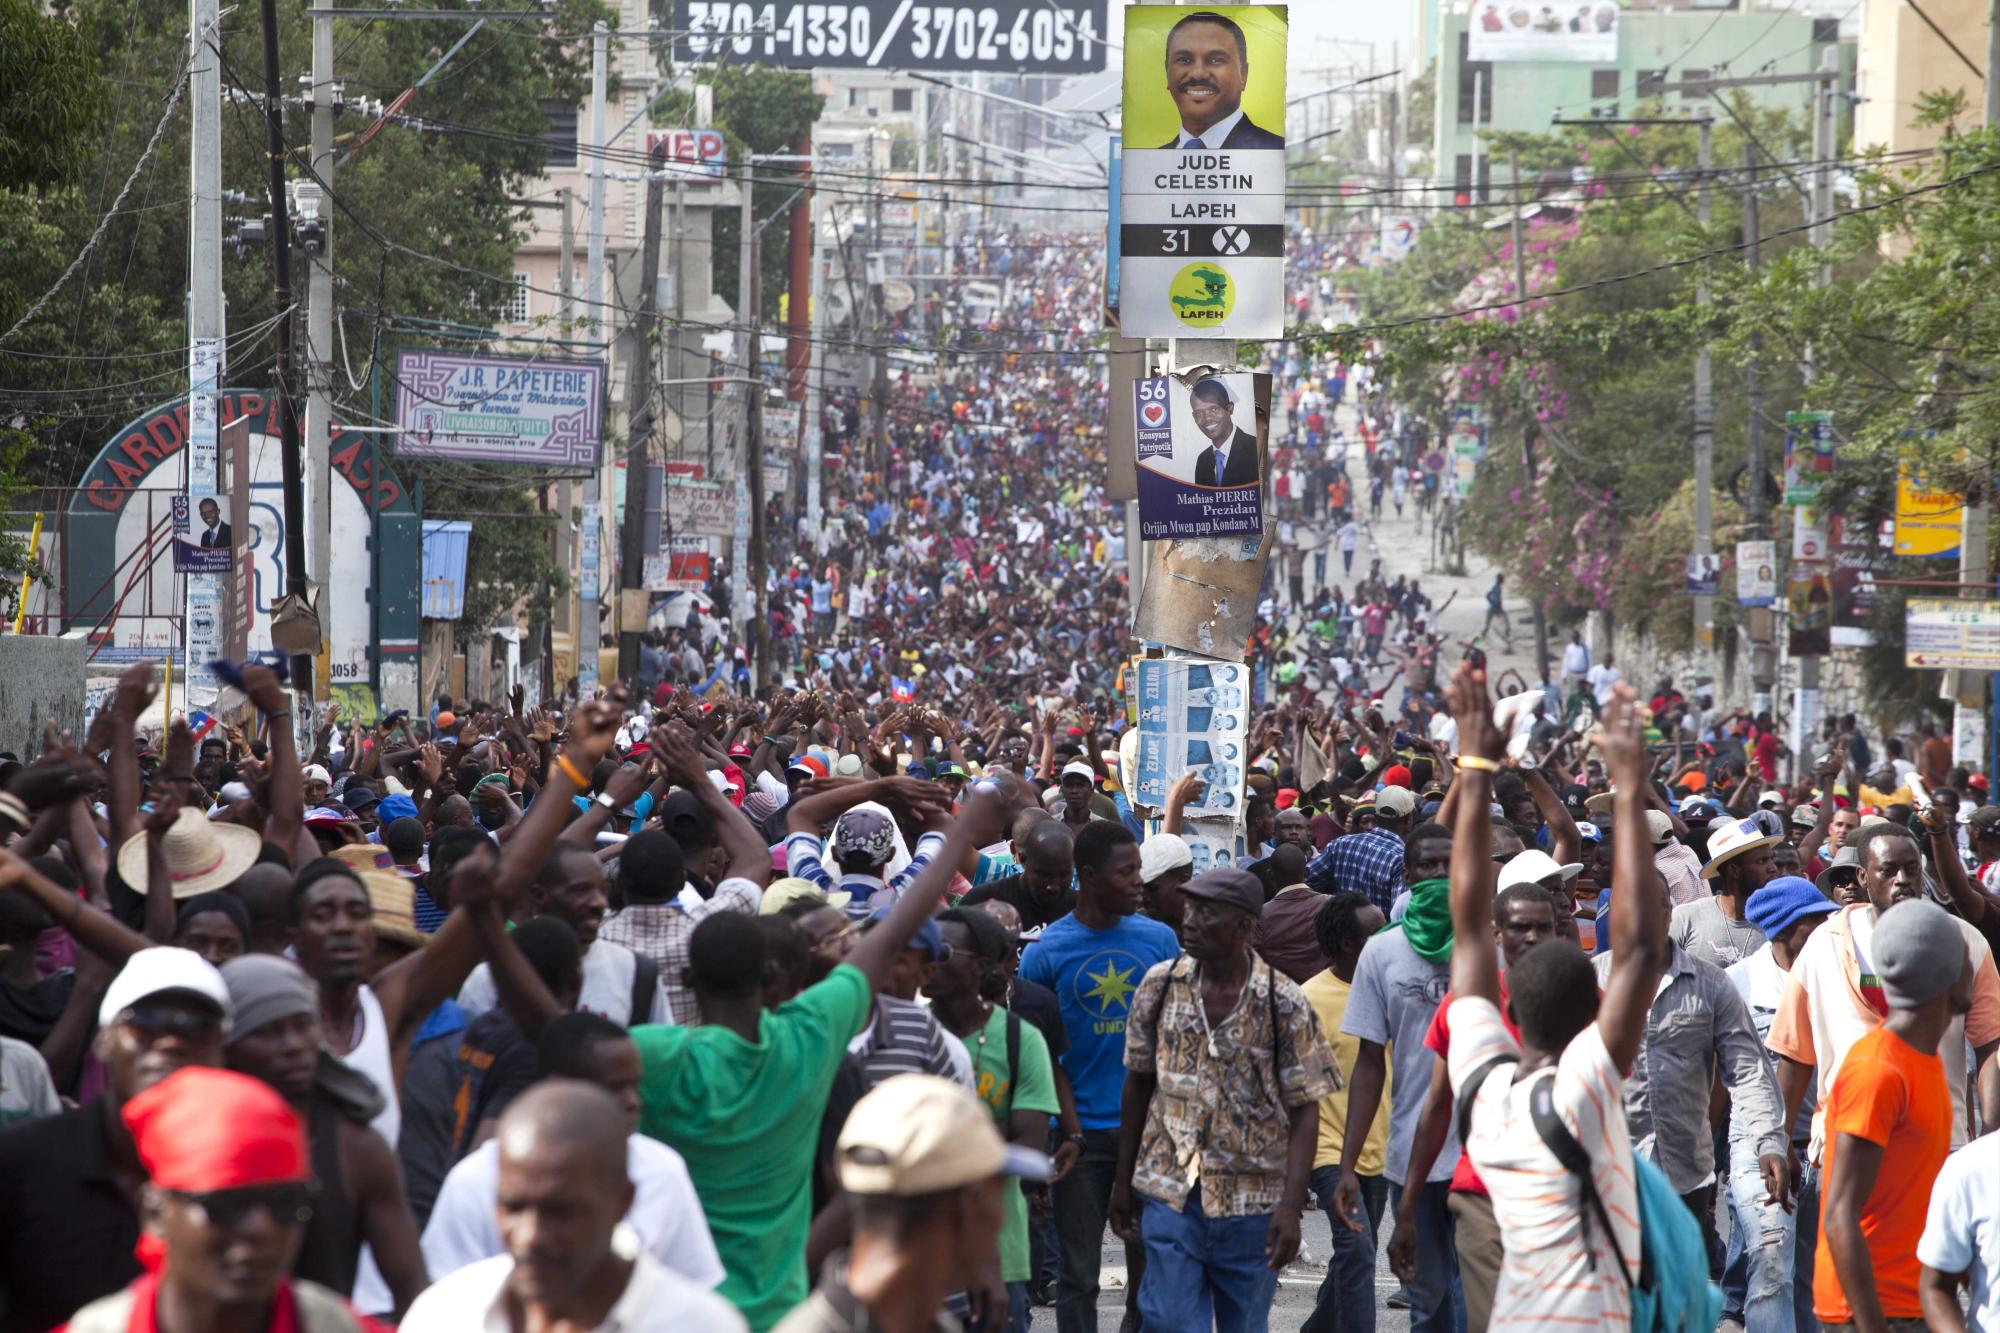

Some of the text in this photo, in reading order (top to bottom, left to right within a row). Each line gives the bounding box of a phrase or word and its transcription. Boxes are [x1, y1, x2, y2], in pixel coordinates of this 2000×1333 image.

[1177, 156, 1230, 170] JUDE
[1154, 174, 1253, 189] CELESTIN
[1171, 204, 1236, 218] LAPEH
[1161, 229, 1190, 252] 31
[1180, 310, 1224, 319] LAPEH
[495, 368, 587, 394] PAPETERIE
[1139, 380, 1167, 401] 56
[446, 415, 548, 434] LIVRAISON GRATUITE
[1138, 431, 1170, 441] Konsyans
[1139, 441, 1172, 454] Patriyotik
[1177, 490, 1256, 505] Mathias PIERRE
[1203, 504, 1256, 516] Prezidan
[1143, 516, 1259, 538] Orijin Mwen pap Kondane M
[331, 663, 358, 678] 1058
[1146, 666, 1160, 699] VOTEZ
[1146, 740, 1160, 772] VOTEZ
